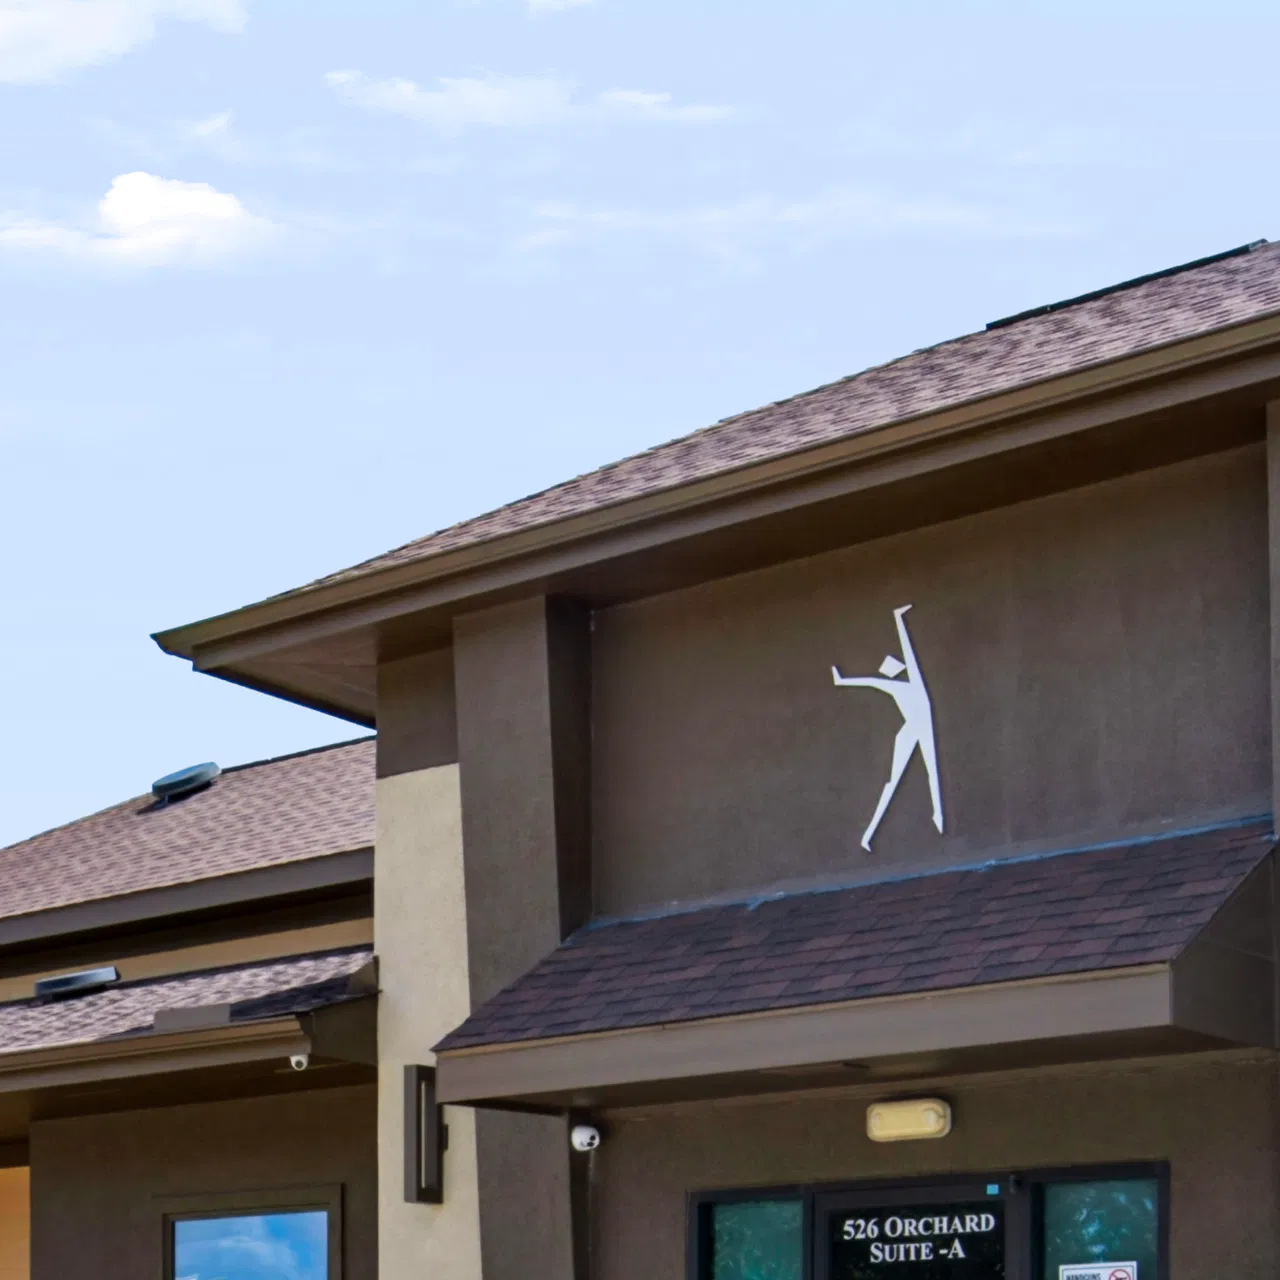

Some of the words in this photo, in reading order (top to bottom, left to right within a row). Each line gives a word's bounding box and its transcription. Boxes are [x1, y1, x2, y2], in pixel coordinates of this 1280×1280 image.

[843, 1218, 879, 1240] 526
[884, 1213, 995, 1238] ORCHARD
[870, 1242, 934, 1263] SUITE
